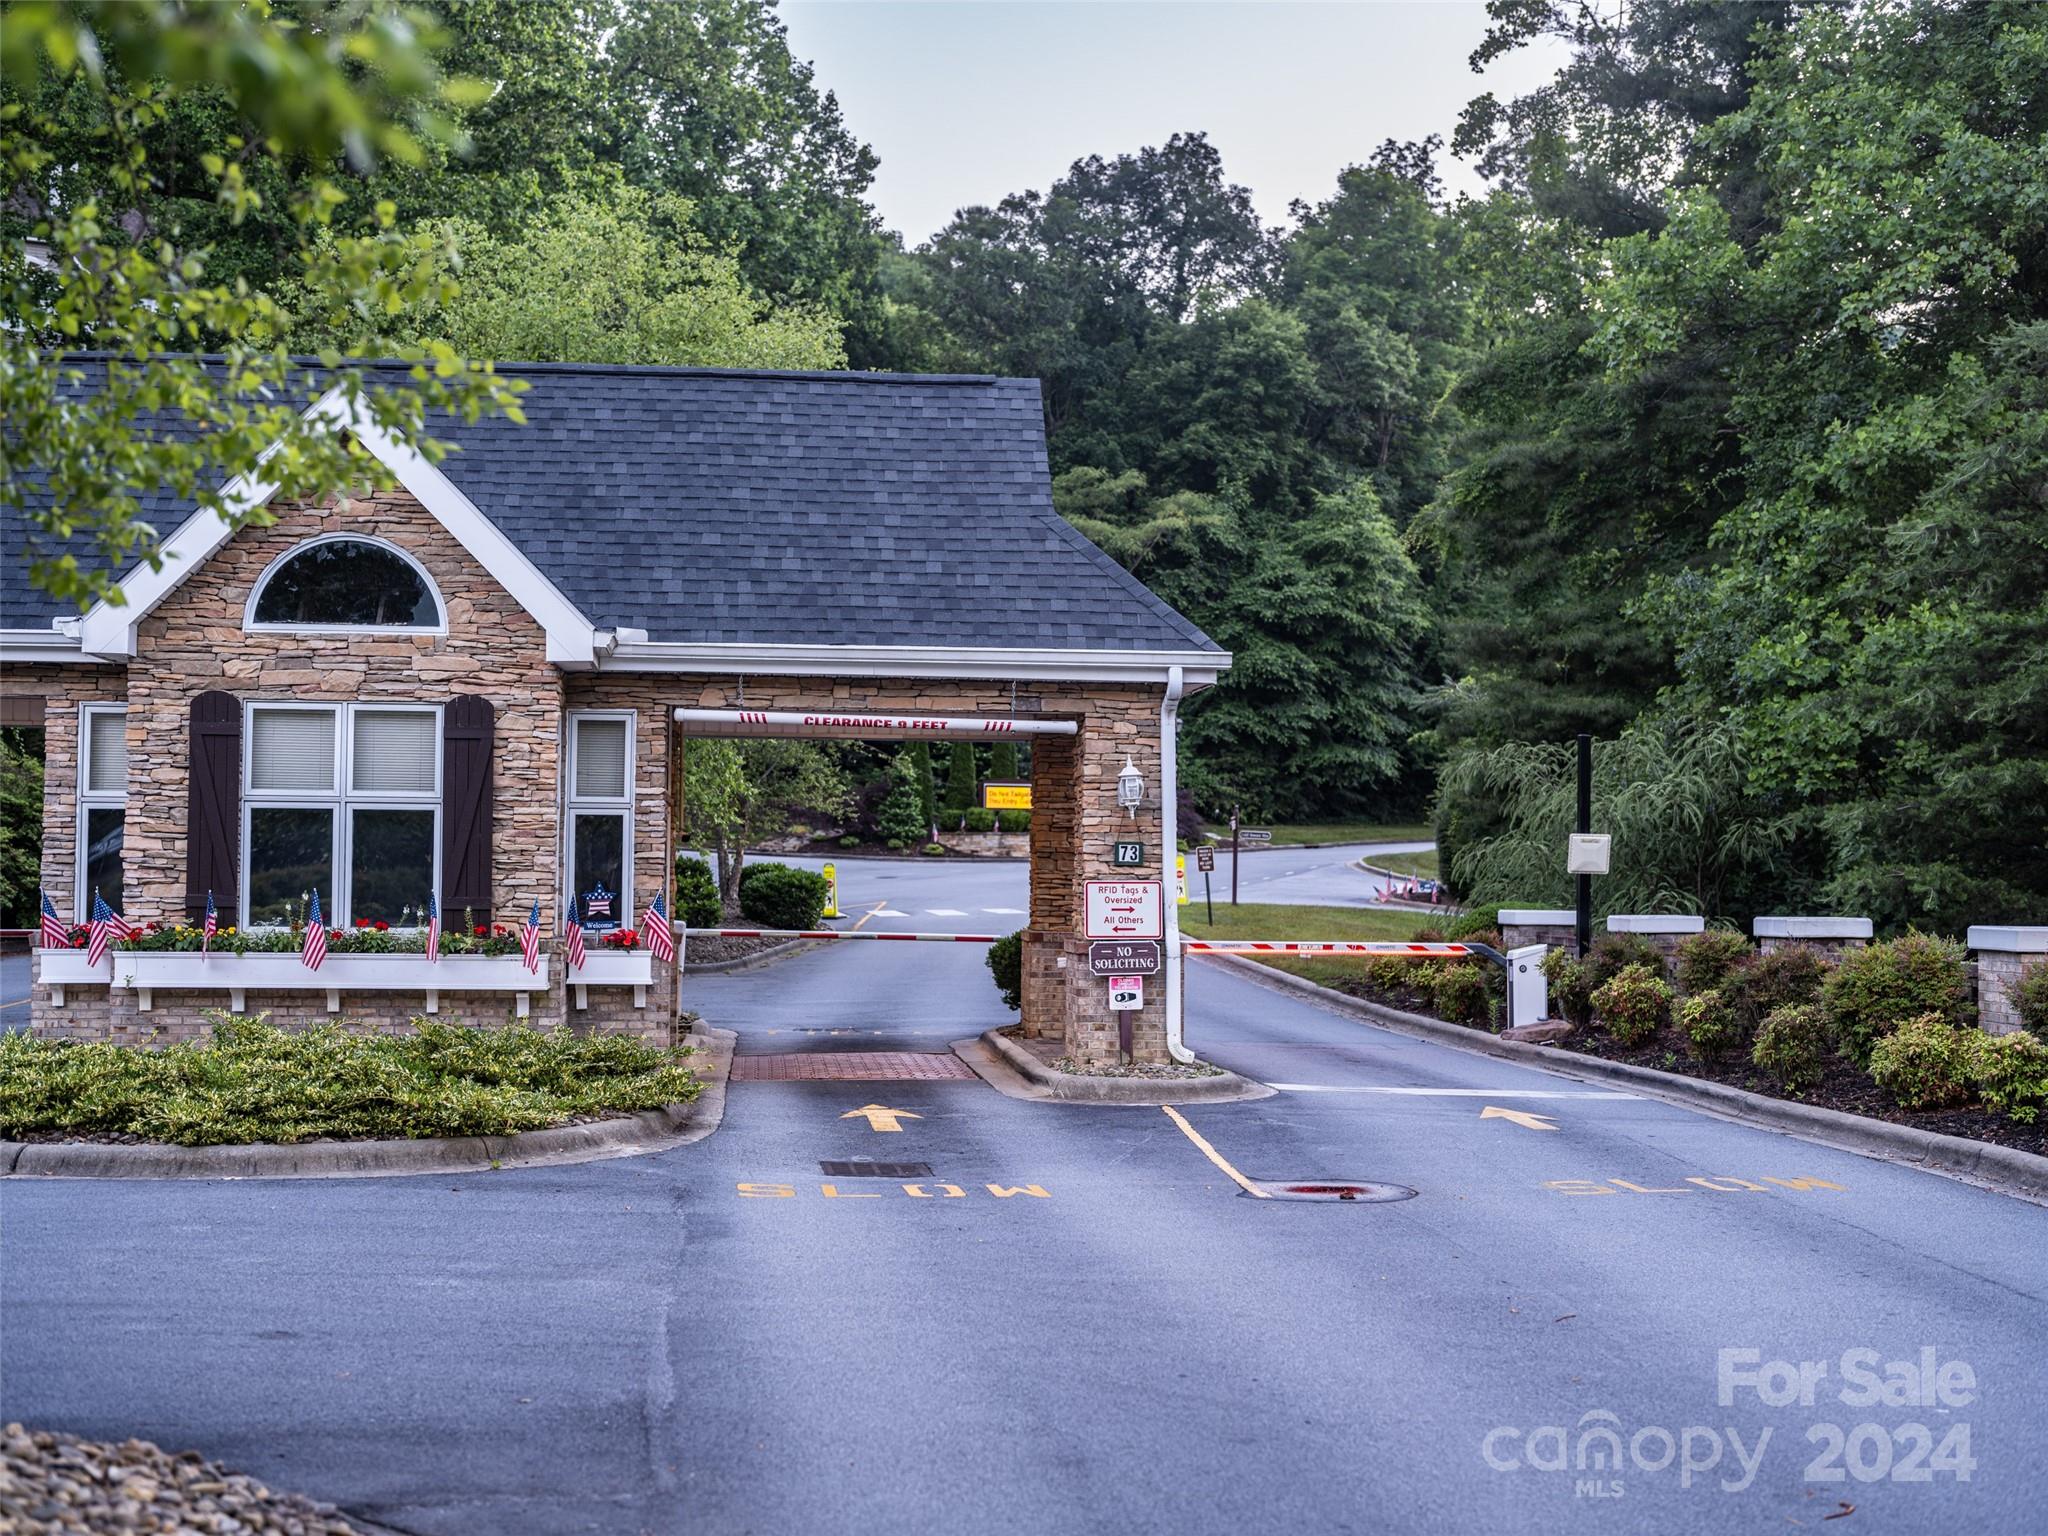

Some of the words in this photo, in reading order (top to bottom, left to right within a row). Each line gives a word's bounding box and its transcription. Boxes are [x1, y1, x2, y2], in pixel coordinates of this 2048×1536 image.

[804, 716, 892, 729] CLEARANCE
[897, 720, 907, 728] 9
[912, 720, 948, 730] FEET
[1120, 845, 1138, 861] 73
[1098, 886, 1117, 894] RFID
[1121, 886, 1139, 896] Tags
[1142, 886, 1149, 894] &
[1104, 896, 1143, 904] Oversized
[1103, 916, 1115, 924] All
[1118, 916, 1144, 924] Others
[1116, 946, 1132, 957] NO
[1095, 958, 1154, 969] SOLICITING
[736, 1183, 1052, 1198] SLOW
[1543, 1176, 1848, 1195] SLOW
